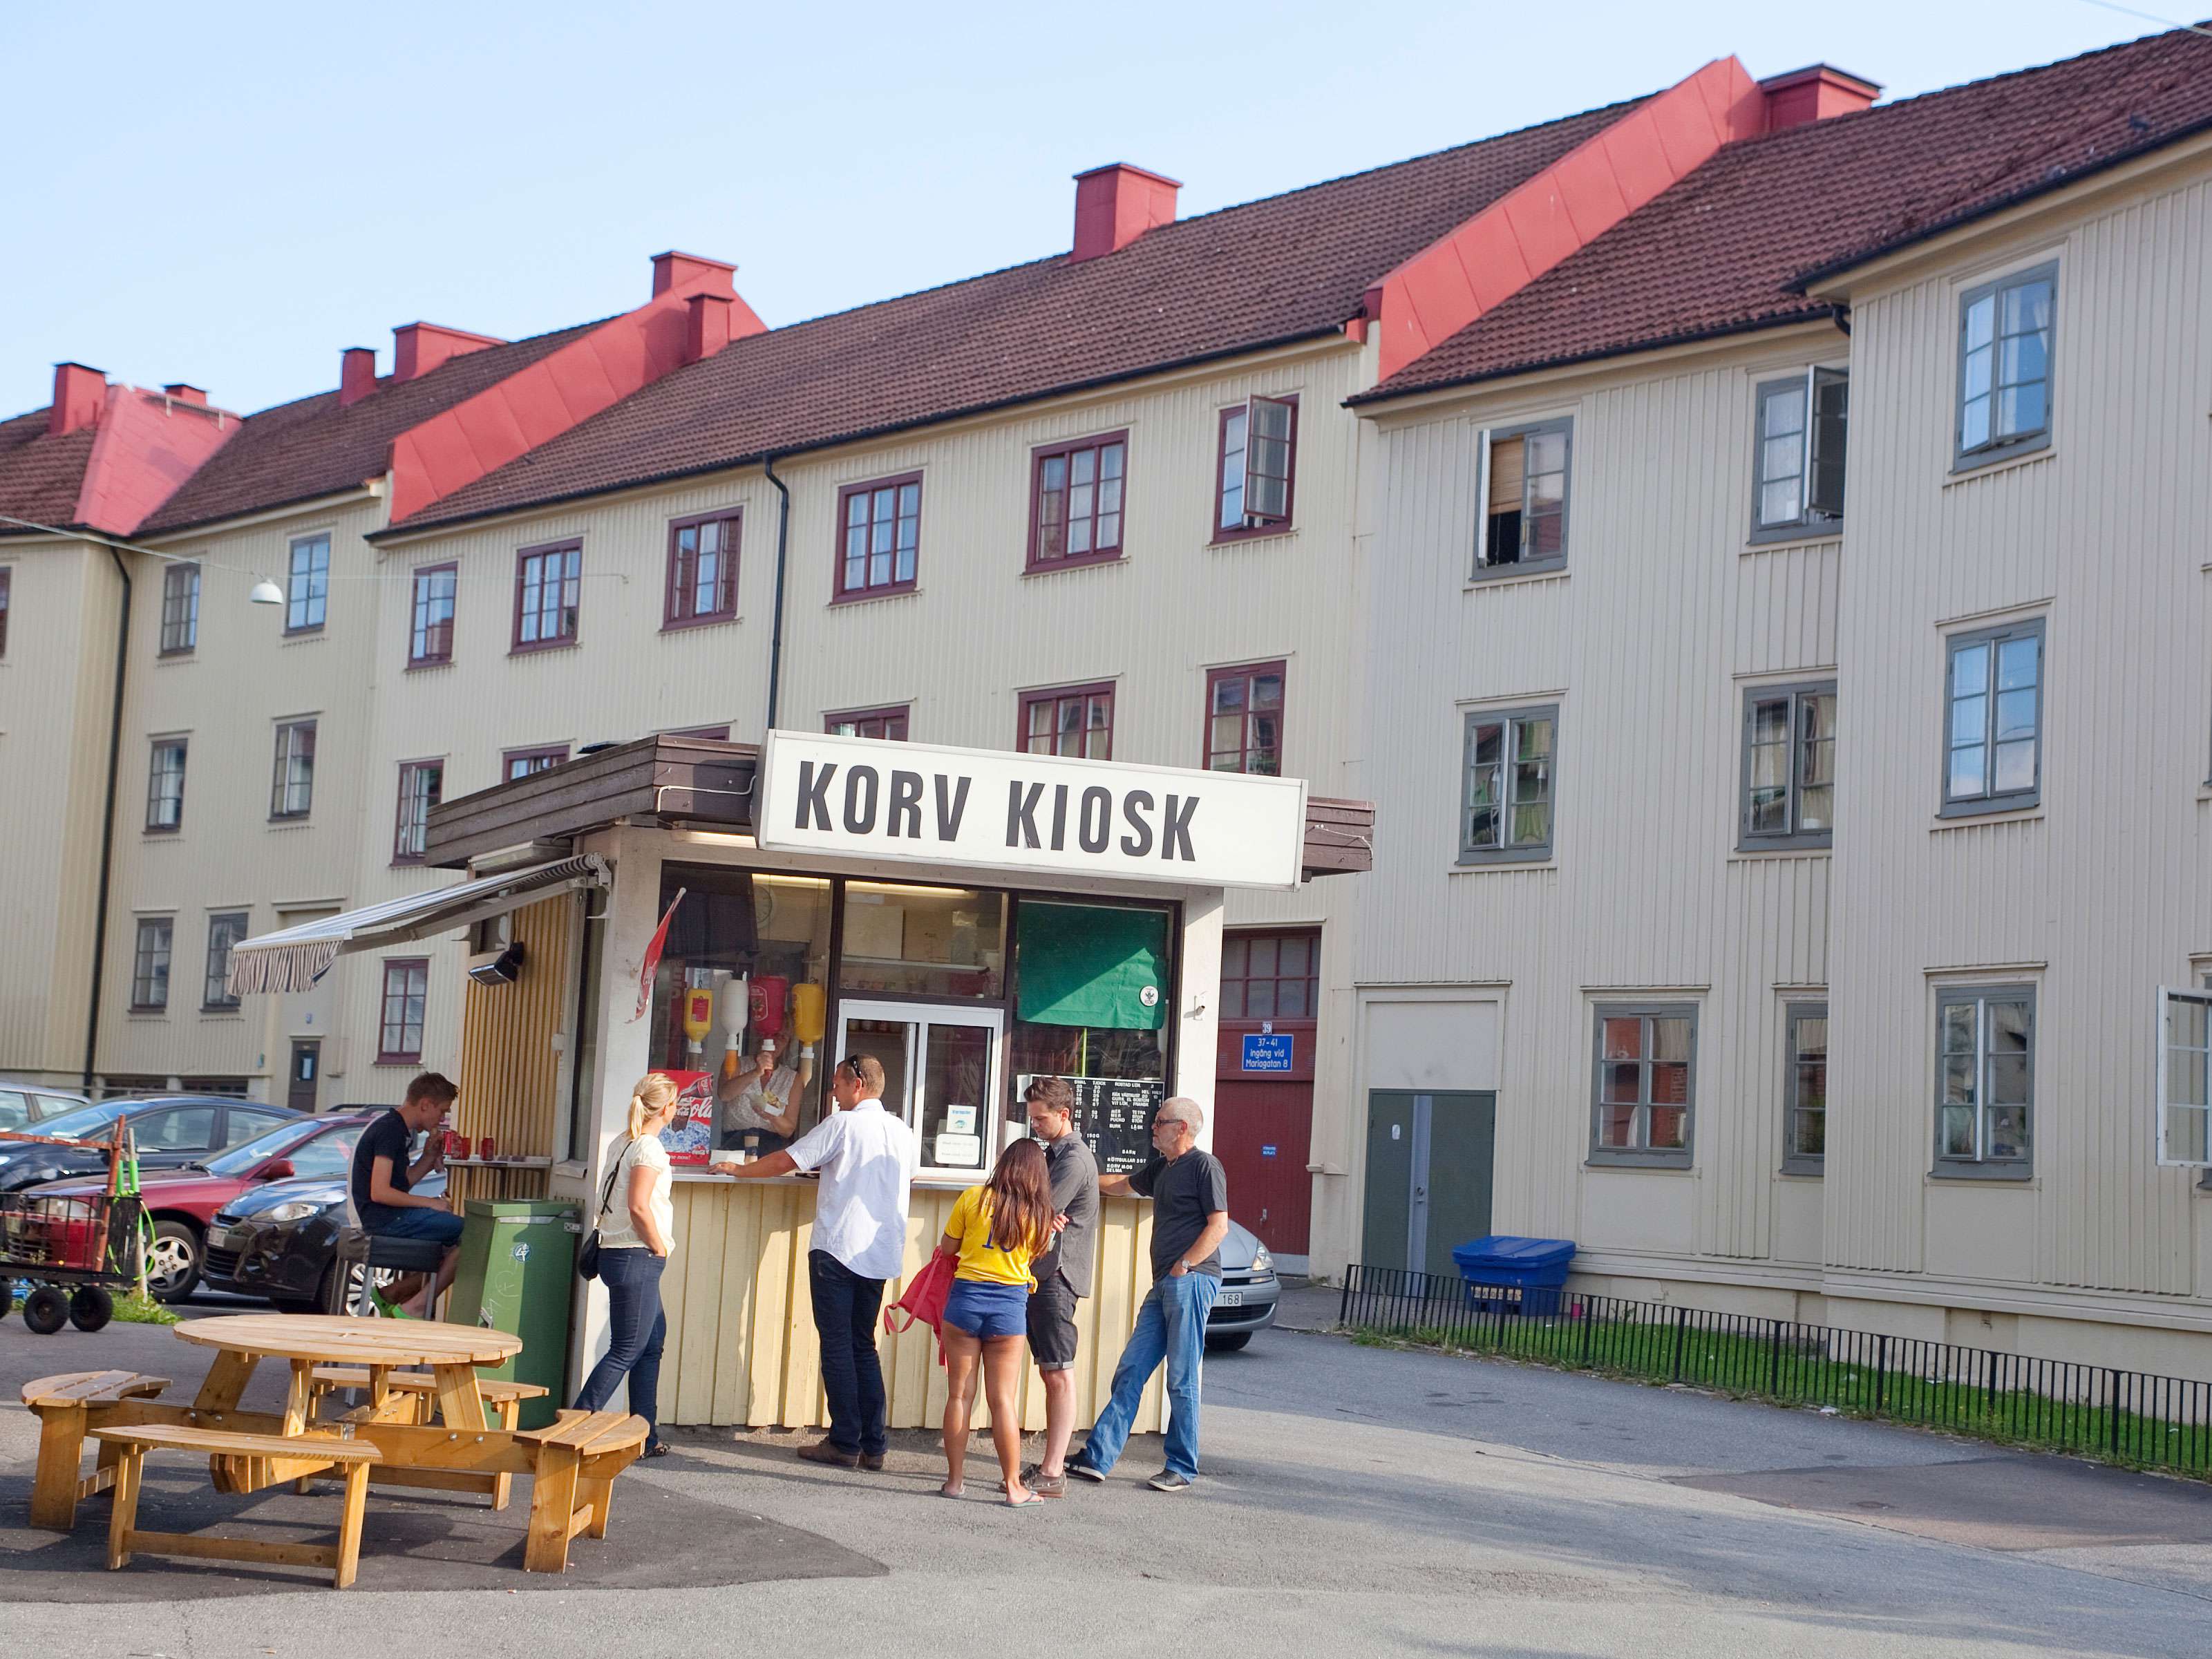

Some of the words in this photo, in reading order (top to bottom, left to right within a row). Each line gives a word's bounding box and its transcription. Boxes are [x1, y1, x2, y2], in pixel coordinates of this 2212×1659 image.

[795, 761, 972, 842] KORV
[1006, 781, 1200, 862] KIOSK
[1263, 1023, 1272, 1034] 39
[1250, 1049, 1272, 1059] Ingång
[1274, 1049, 1285, 1057] vid
[1246, 1059, 1281, 1069] Mariagatan
[1283, 1059, 1288, 1068] 8
[1222, 1294, 1240, 1305] 168
